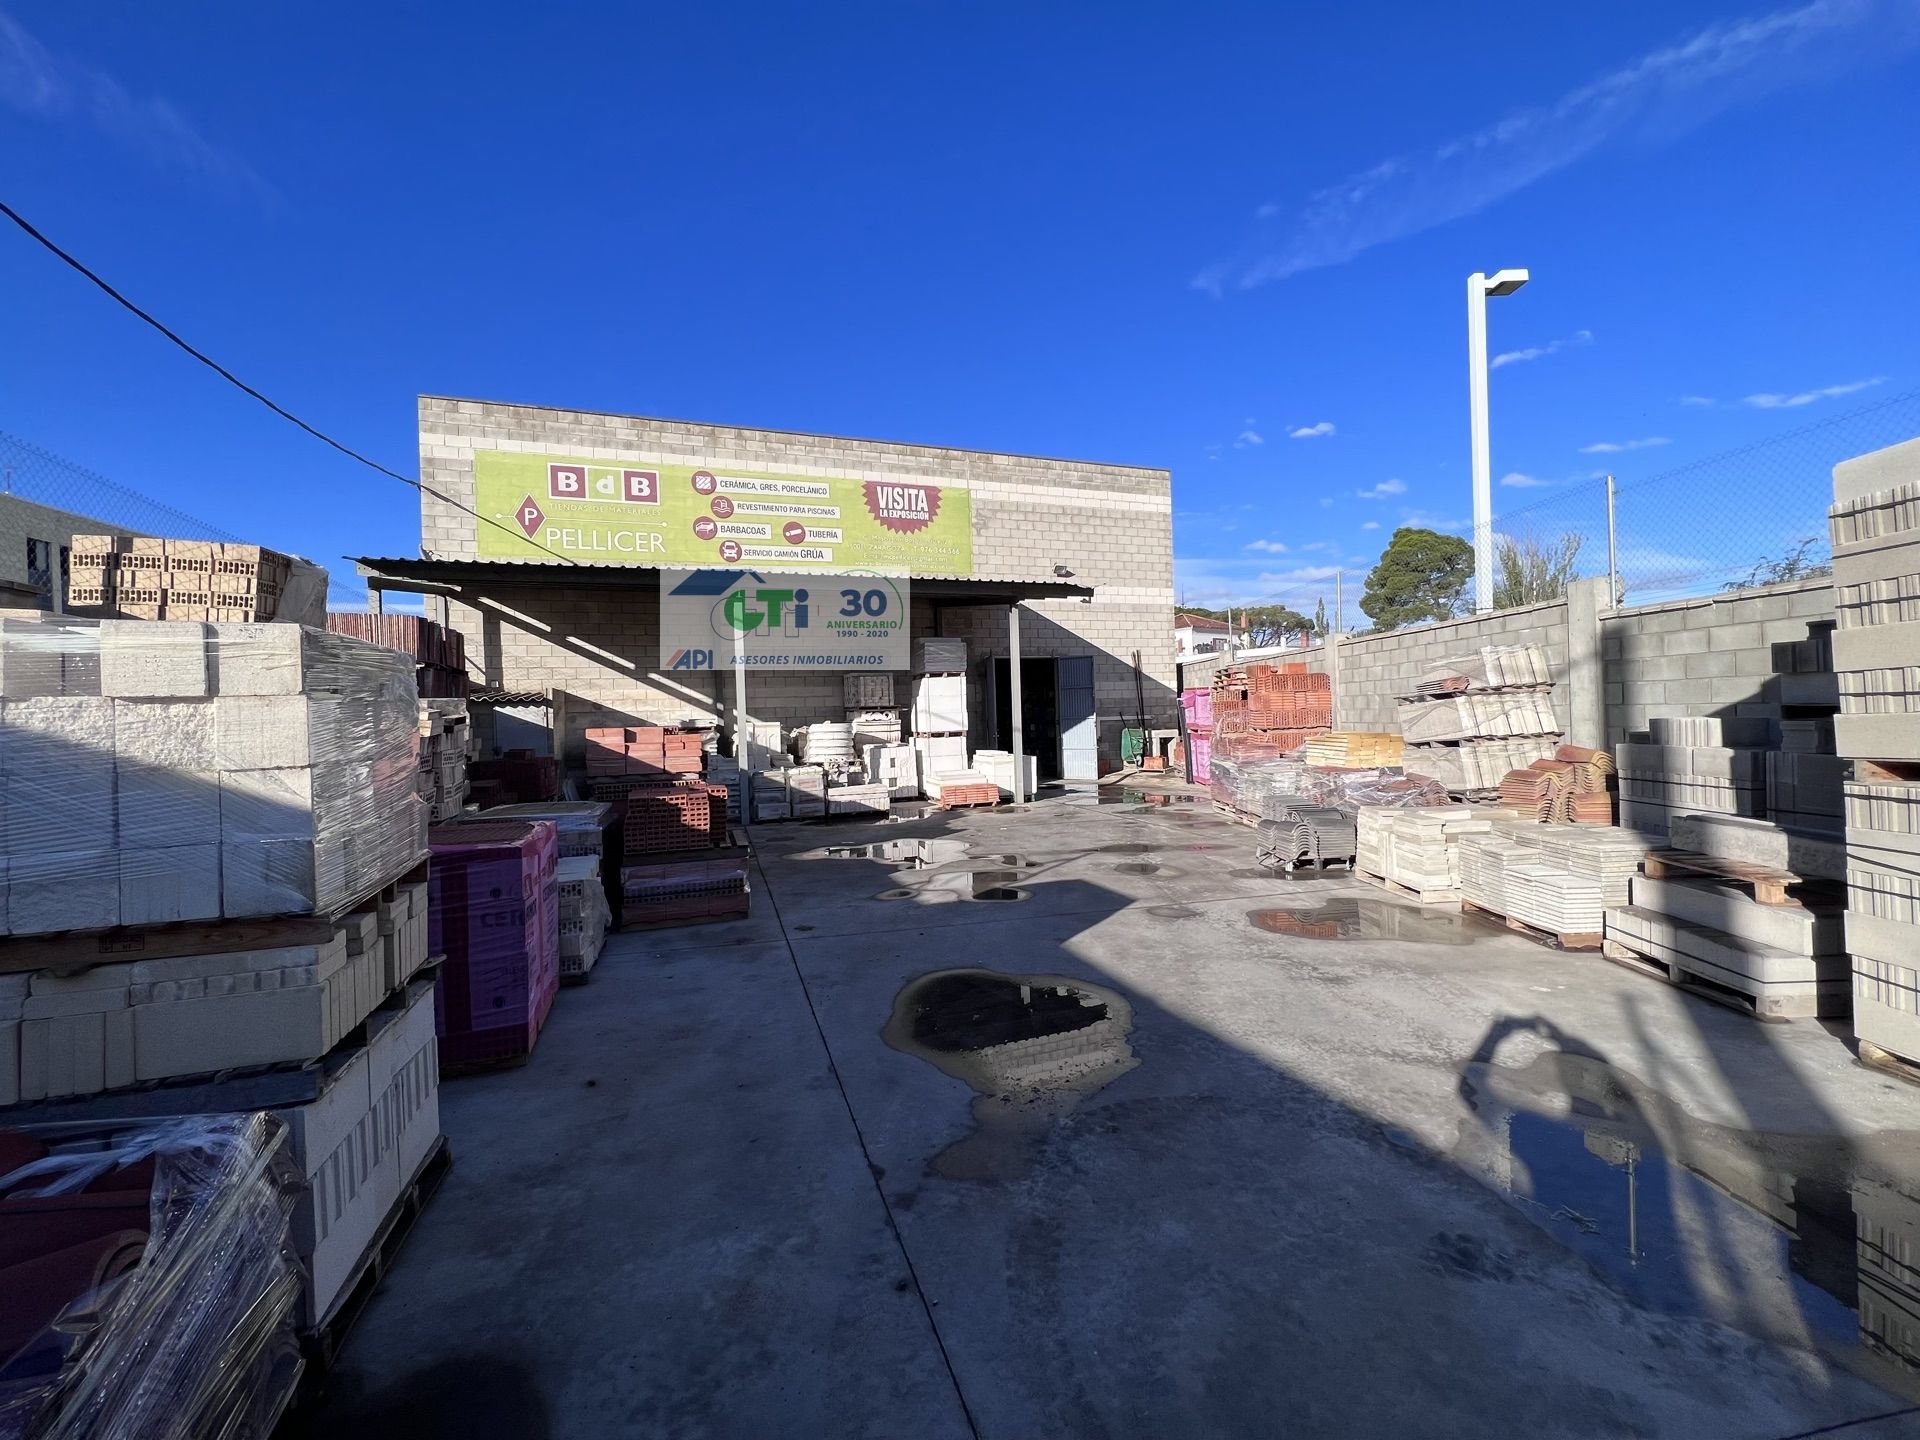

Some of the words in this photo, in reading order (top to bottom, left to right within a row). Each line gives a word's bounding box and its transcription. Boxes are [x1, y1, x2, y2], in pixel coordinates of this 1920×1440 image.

[719, 479, 759, 493] CERÁMICA,
[760, 482, 780, 493] GRES,
[781, 483, 828, 496] PORCELÁNICO
[876, 485, 929, 512] VISITA
[737, 502, 788, 513] REVESTIMIENTO
[789, 504, 806, 514] PARA
[806, 505, 836, 516] PISCINAS
[879, 509, 888, 518] LA
[888, 509, 930, 521] EXPOSICIÓN
[524, 507, 538, 526] P
[719, 524, 767, 536] BARBACOAS
[808, 528, 839, 540] TUBERÍA
[546, 527, 667, 554] PELLICER
[743, 548, 772, 558] SERVICIO
[773, 549, 799, 559] CAMIÓN
[800, 548, 825, 560] GRÚA
